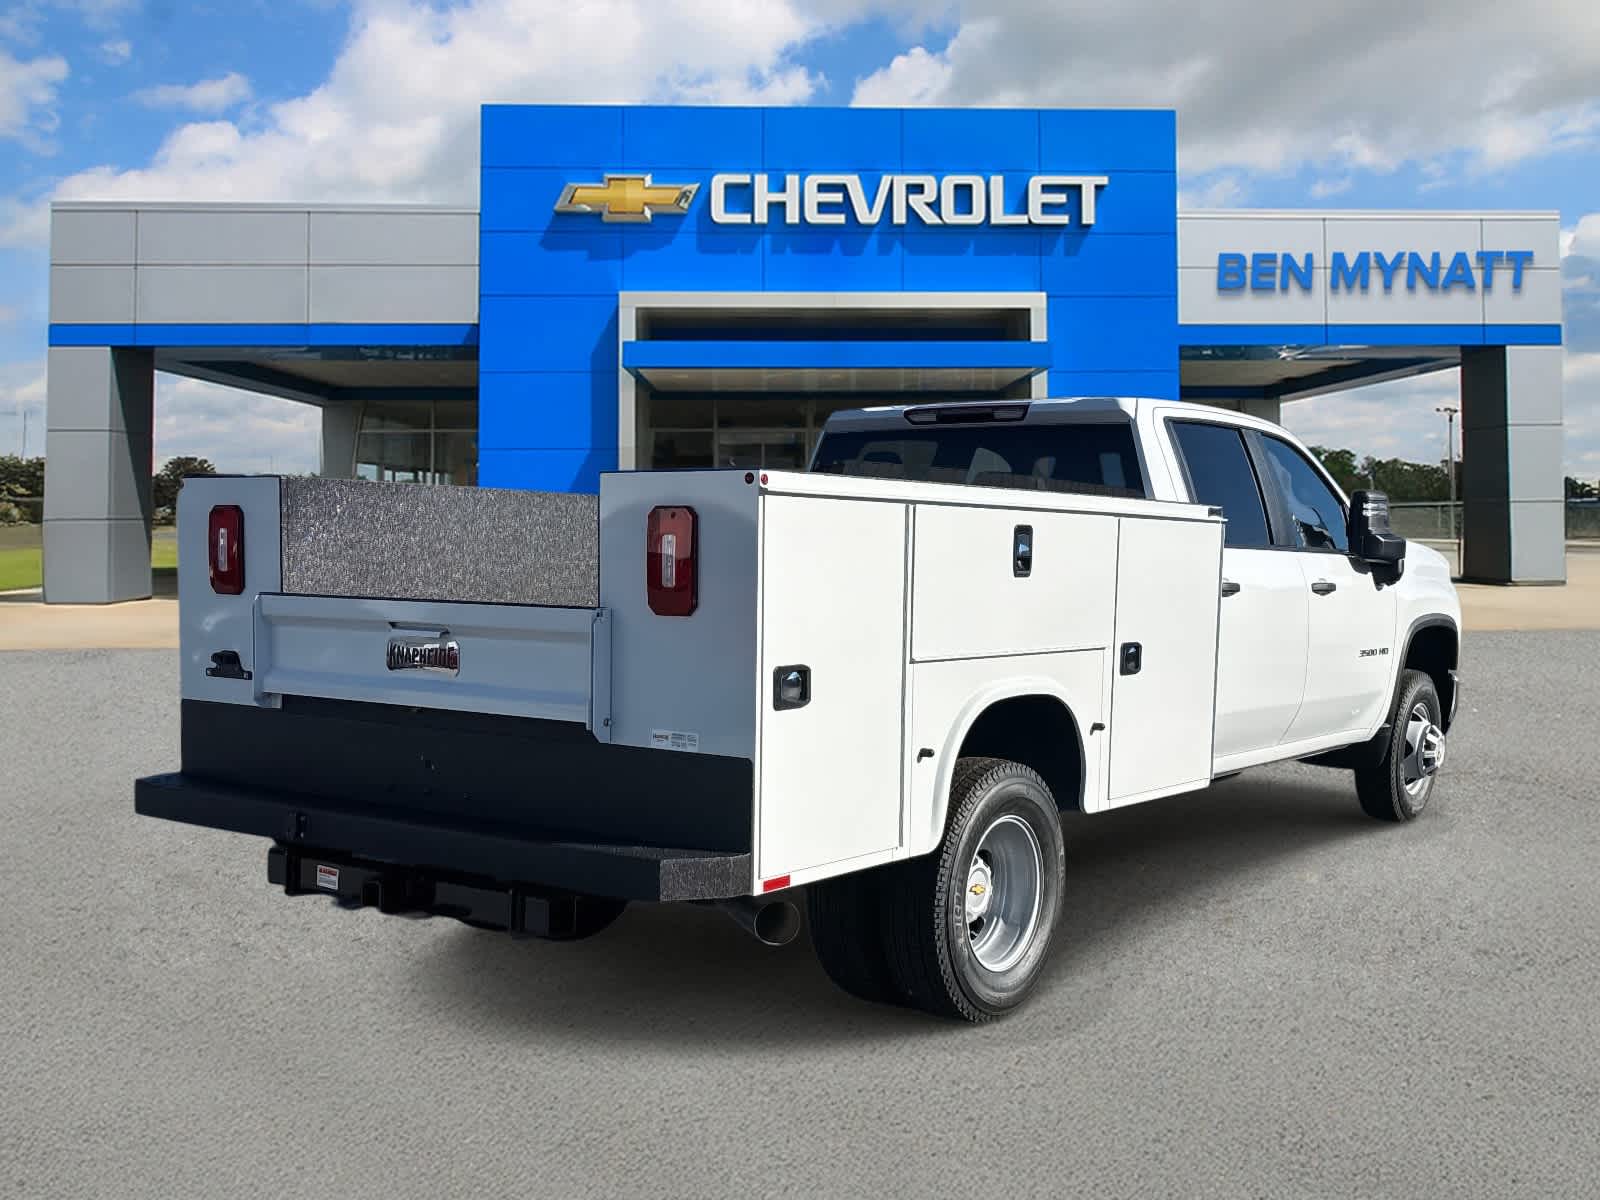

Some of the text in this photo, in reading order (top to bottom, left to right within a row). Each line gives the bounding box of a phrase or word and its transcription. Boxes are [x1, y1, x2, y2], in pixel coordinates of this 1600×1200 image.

[710, 173, 1109, 225] CHEVROLET
[1217, 251, 1534, 290] BEN MYNATT
[1359, 647, 1389, 657] 3500 HD
